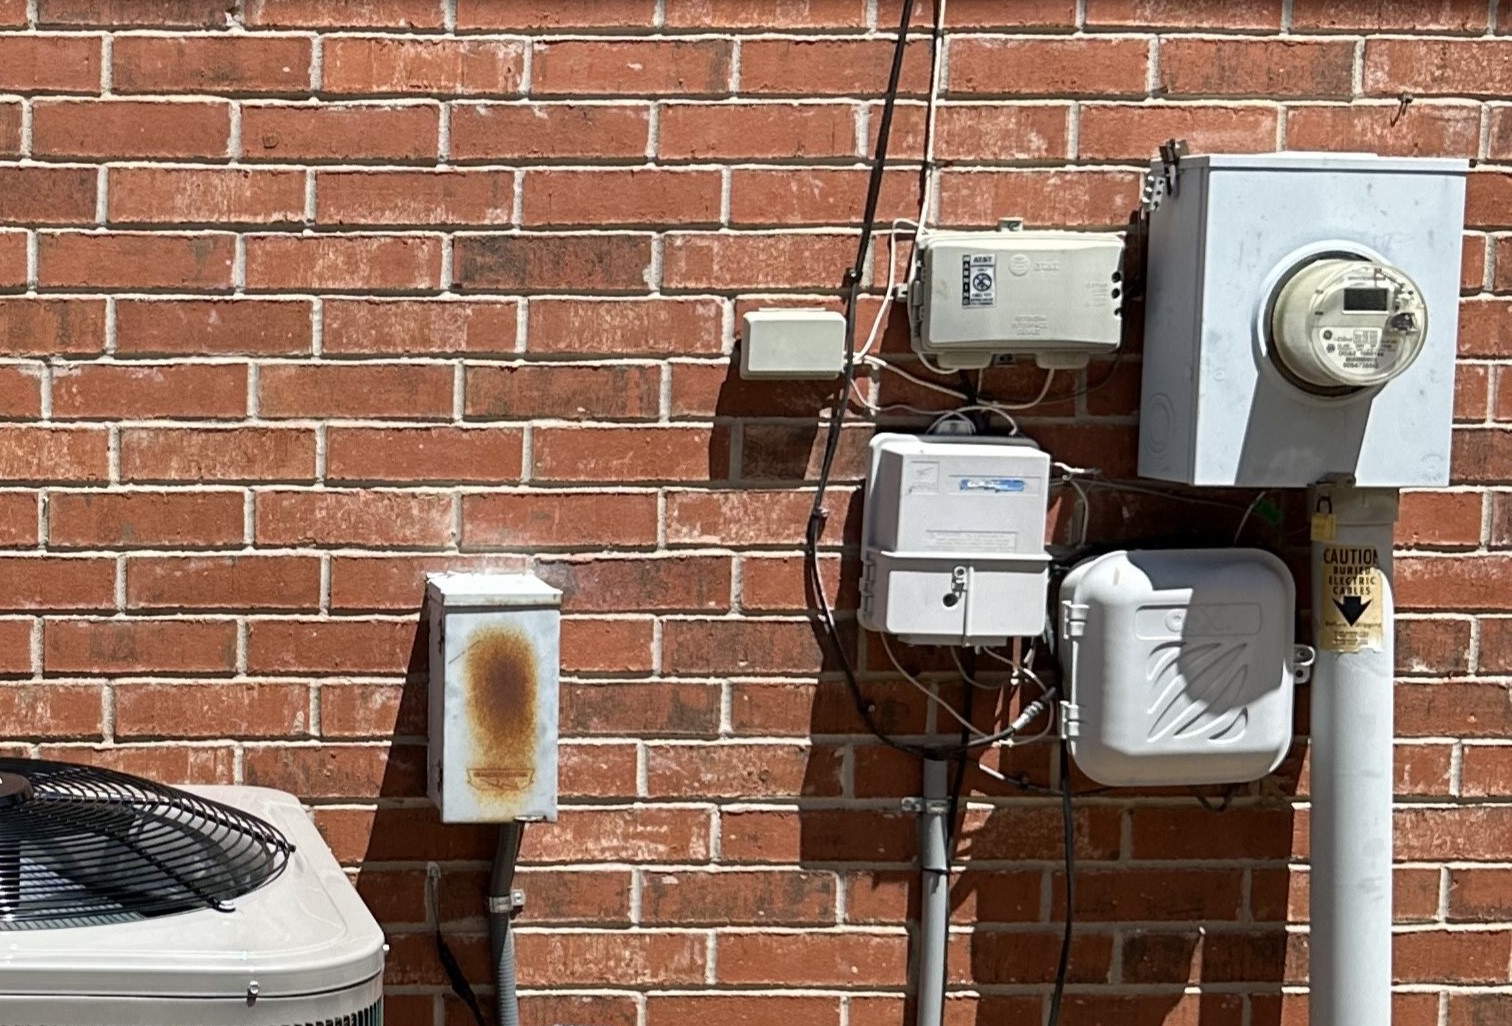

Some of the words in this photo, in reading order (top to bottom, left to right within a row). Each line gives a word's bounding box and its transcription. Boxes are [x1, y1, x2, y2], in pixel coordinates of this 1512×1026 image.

[1333, 566, 1371, 575] BURIED
[1329, 576, 1376, 585] ELECTRIC
[1332, 586, 1371, 595] CABLES
